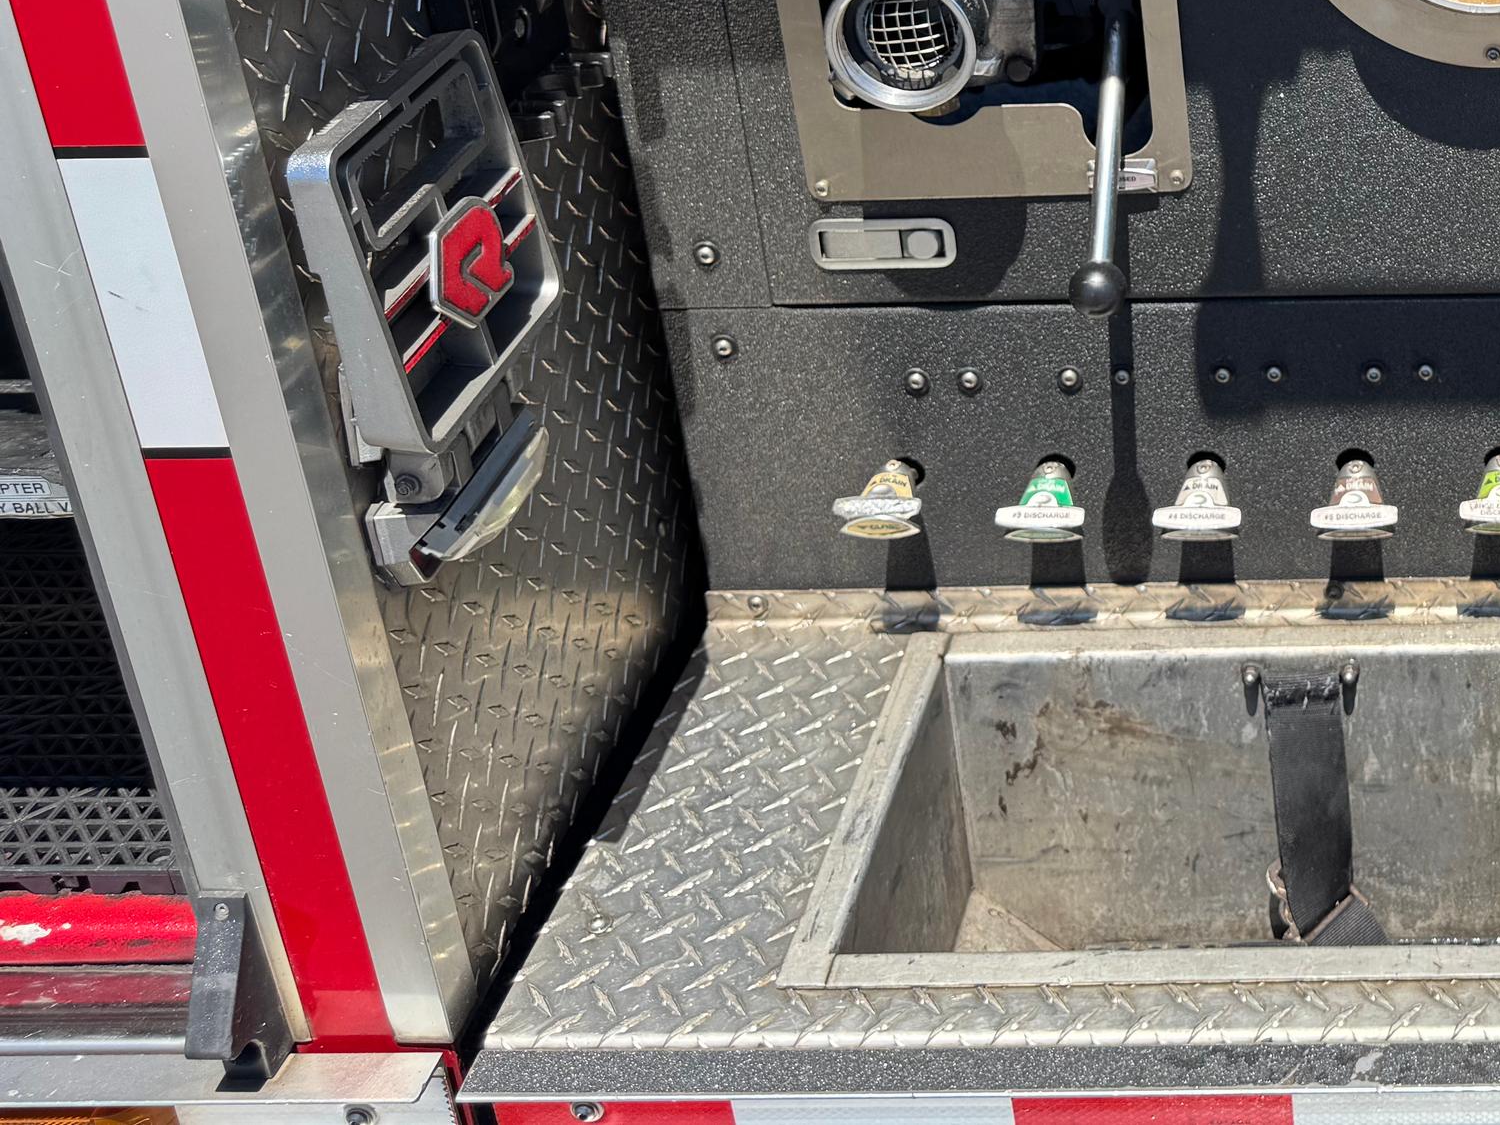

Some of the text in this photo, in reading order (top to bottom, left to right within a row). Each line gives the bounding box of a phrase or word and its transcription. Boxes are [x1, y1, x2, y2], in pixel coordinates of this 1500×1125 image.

[0, 482, 46, 494] PTER
[12, 502, 55, 514] BALL
[1336, 512, 1381, 520] DISCHARGE
